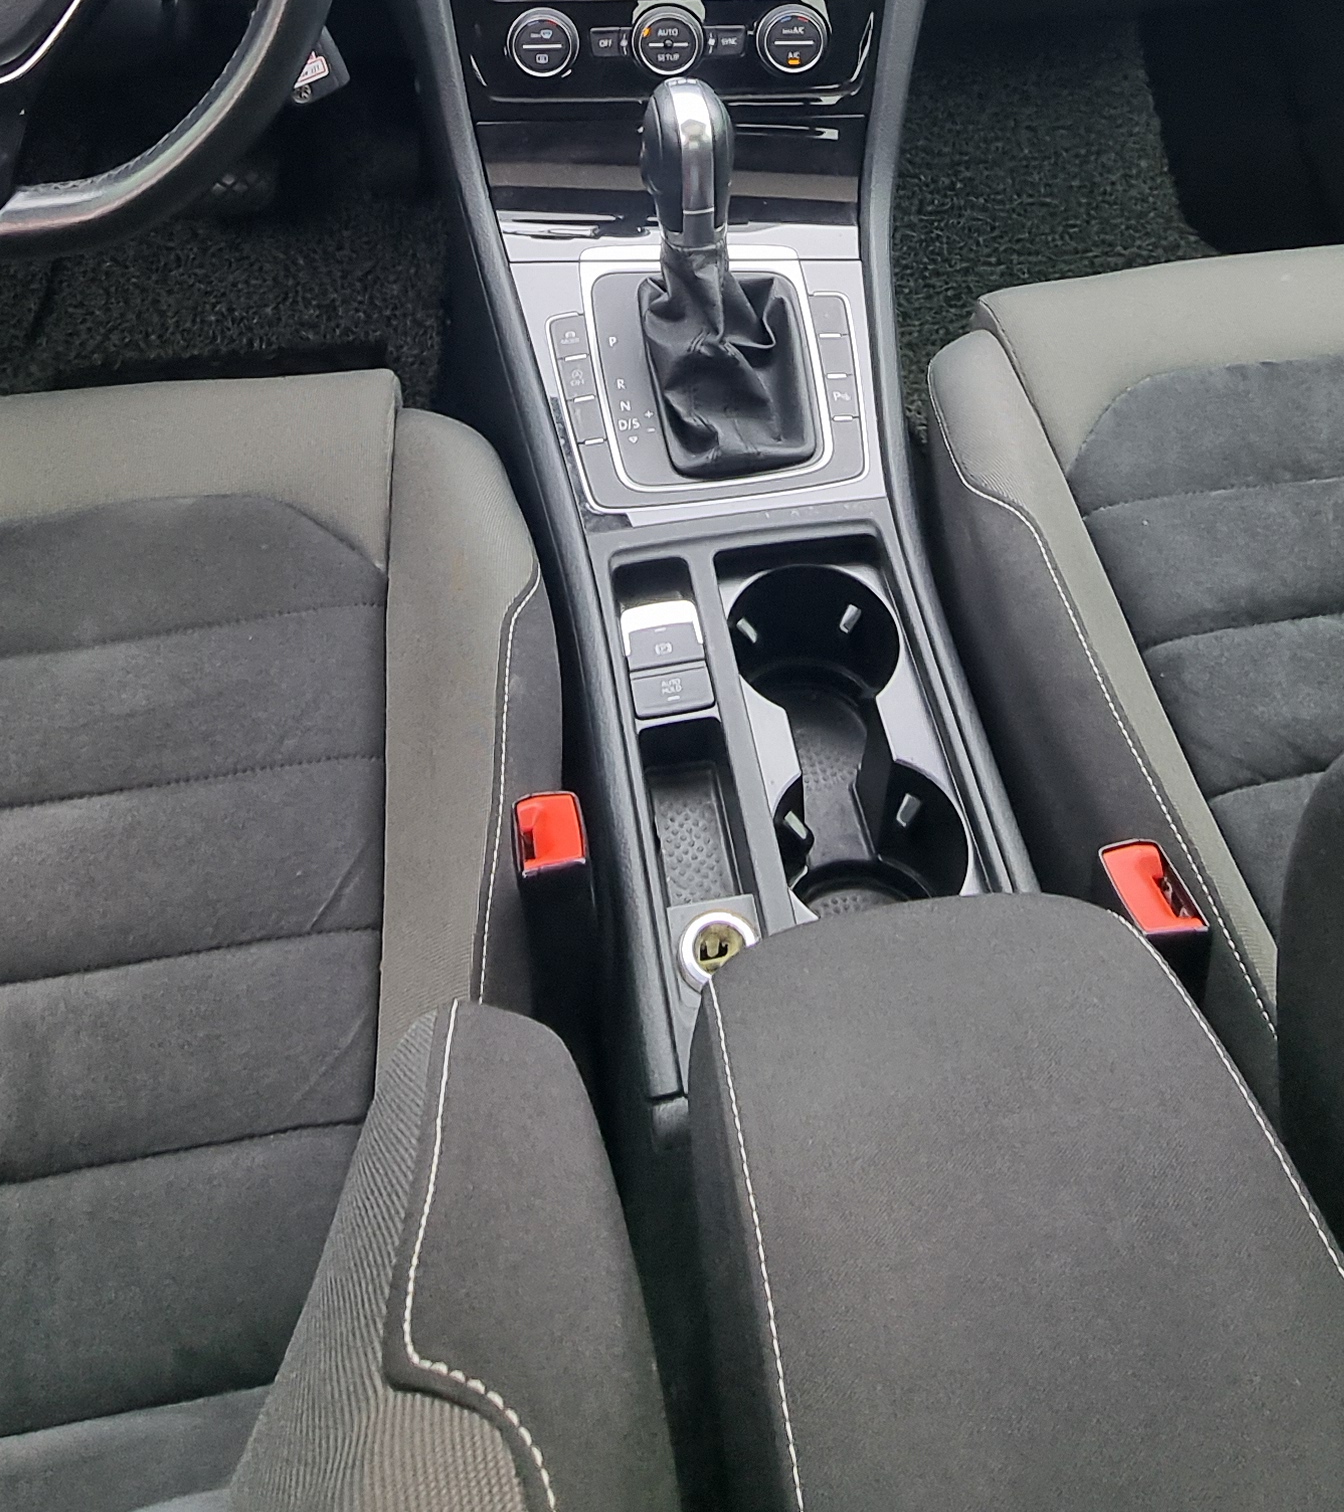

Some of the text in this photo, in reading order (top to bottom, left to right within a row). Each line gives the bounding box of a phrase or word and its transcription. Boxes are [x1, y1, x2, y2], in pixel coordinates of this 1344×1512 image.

[658, 29, 678, 37] AUTO
[598, 39, 613, 48] OFF
[608, 336, 617, 347] P
[617, 378, 626, 389] R
[620, 400, 632, 411] N
